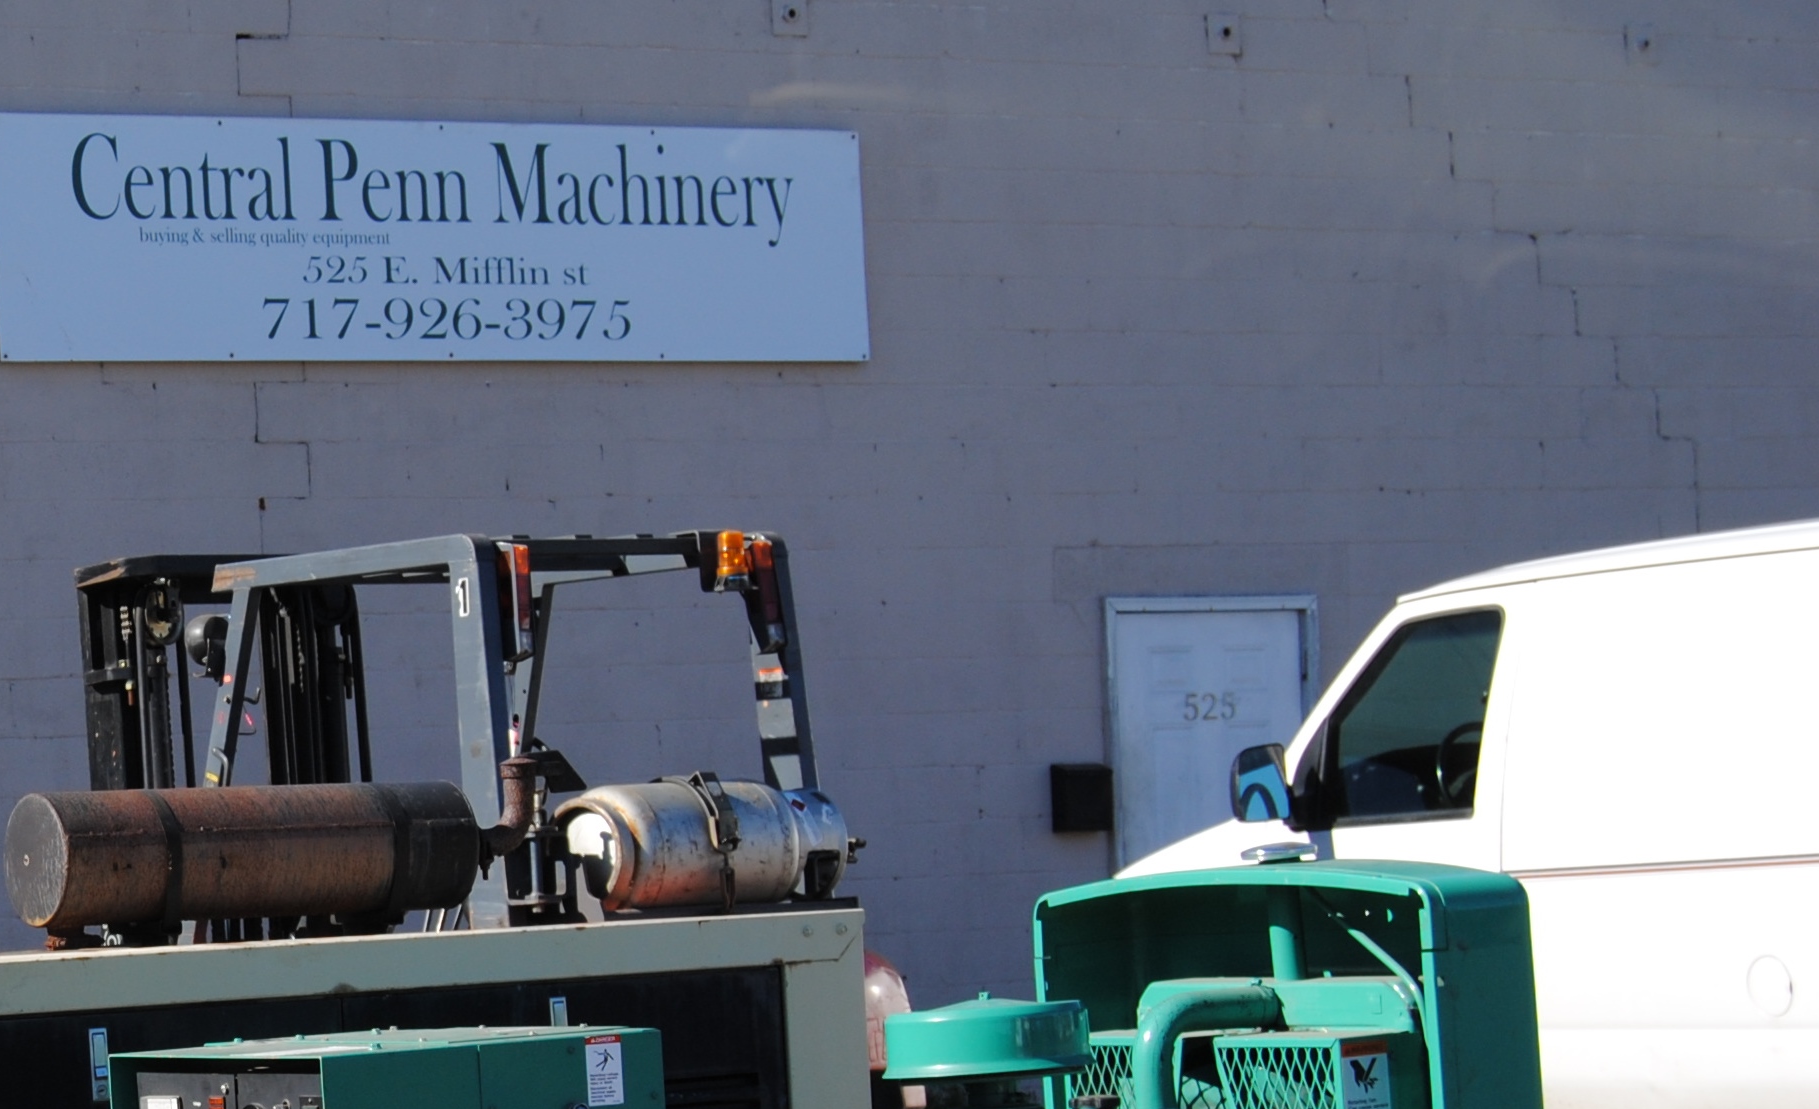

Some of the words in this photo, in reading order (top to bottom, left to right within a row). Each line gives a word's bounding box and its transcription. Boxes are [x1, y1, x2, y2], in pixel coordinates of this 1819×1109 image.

[71, 132, 298, 221] Central
[315, 138, 472, 223] Penn
[489, 141, 794, 247] Machinery
[139, 226, 189, 247] buying
[192, 227, 205, 243] &
[210, 227, 257, 247] selling
[260, 228, 308, 248] quality
[312, 230, 391, 249] equipment
[302, 255, 368, 285] 525
[383, 256, 419, 285] E.
[433, 255, 550, 286] Mifflin
[563, 263, 590, 286] st
[261, 297, 632, 341] 717-926-3975
[1183, 692, 1237, 723] 525
